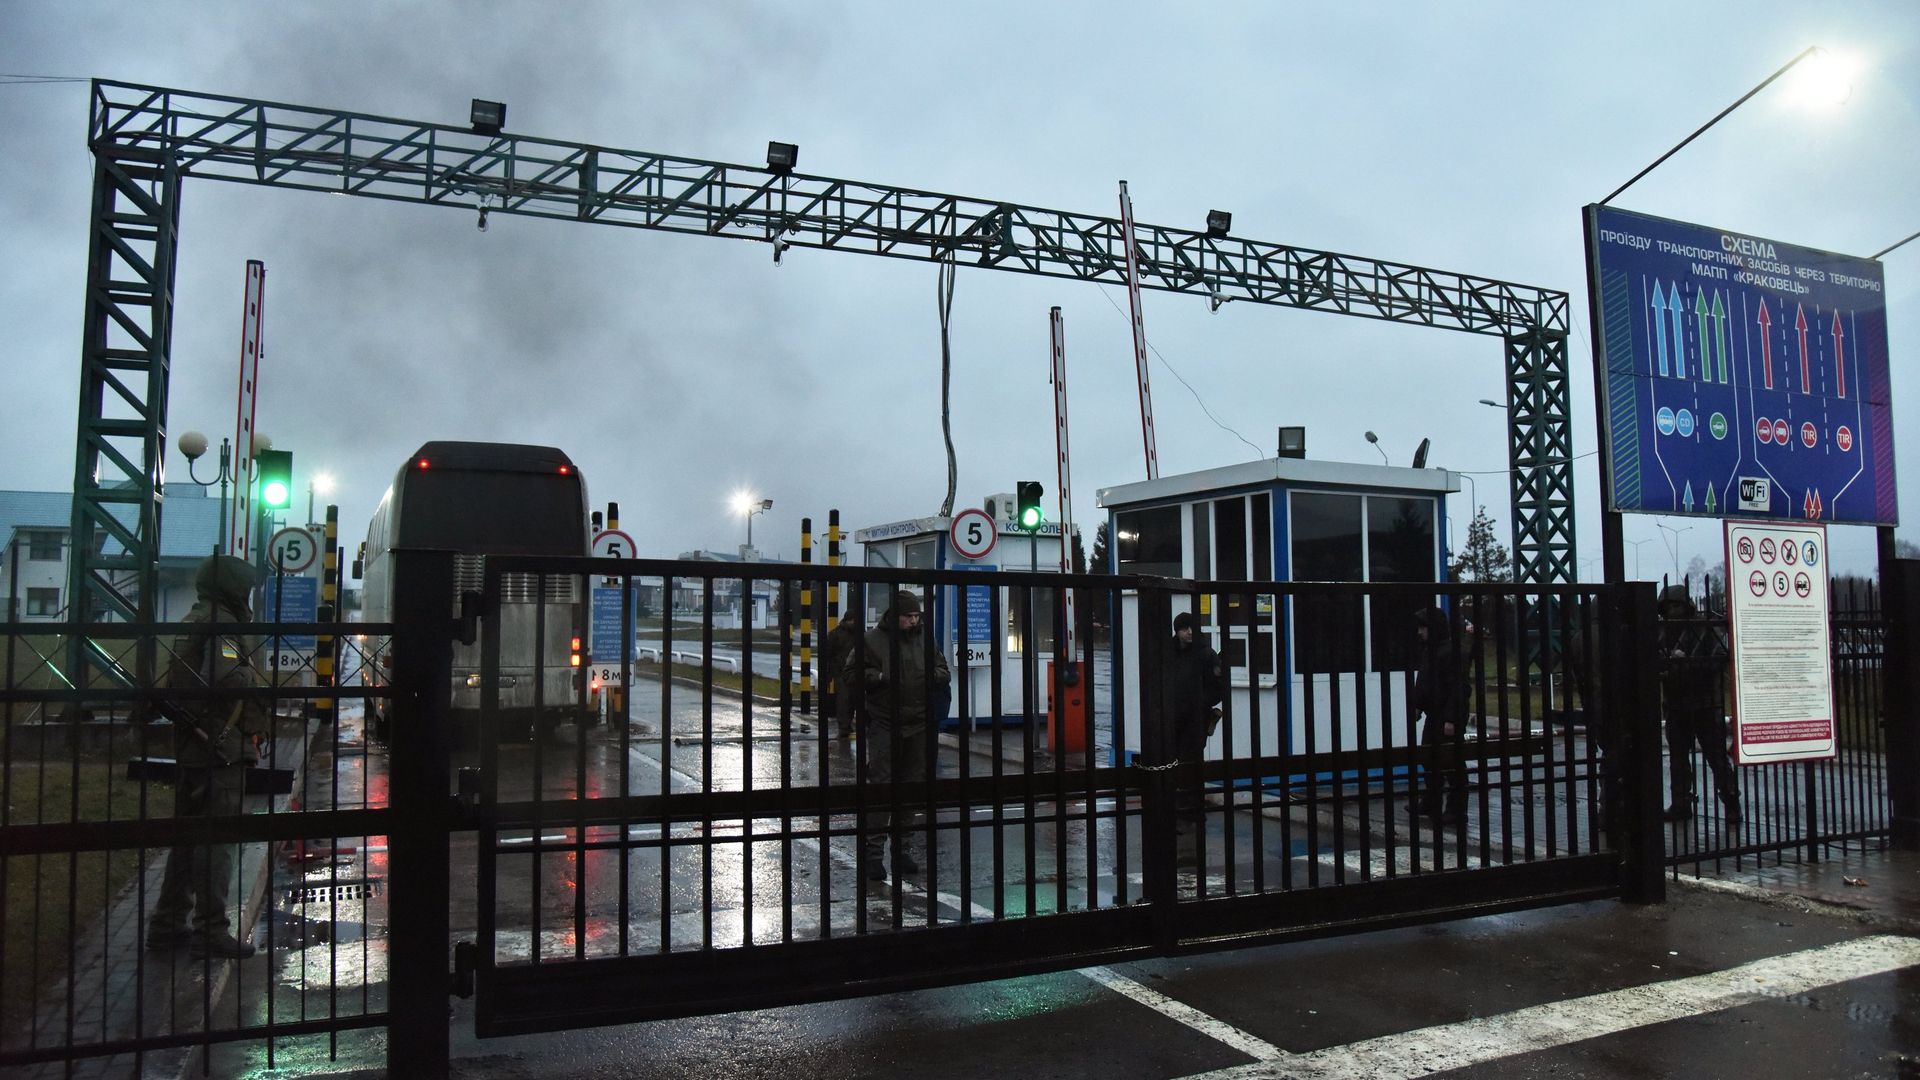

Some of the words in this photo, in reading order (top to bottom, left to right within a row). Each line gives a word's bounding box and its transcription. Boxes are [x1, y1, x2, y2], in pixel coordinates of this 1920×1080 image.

[1720, 235, 1777, 260] СХЕМА
[1600, 230, 1651, 250] ПРОЇЗДУ
[1657, 240, 1743, 267] ТРАНСПОРТНИХ
[1748, 257, 1790, 275] ЗАСОБІВ
[1795, 266, 1825, 282] ЧЕРЕЗ
[1829, 272, 1881, 292] ТЕРИТОРІЮ
[1692, 263, 1728, 280] МАПП
[1734, 271, 1810, 295] «КРАКОВЕЦЬ»
[1803, 429, 1815, 440] TIR
[1838, 433, 1850, 444] TIR
[967, 522, 982, 545] 5
[286, 540, 301, 561] 5
[607, 543, 621, 559] 5
[1778, 577, 1785, 591] 5
